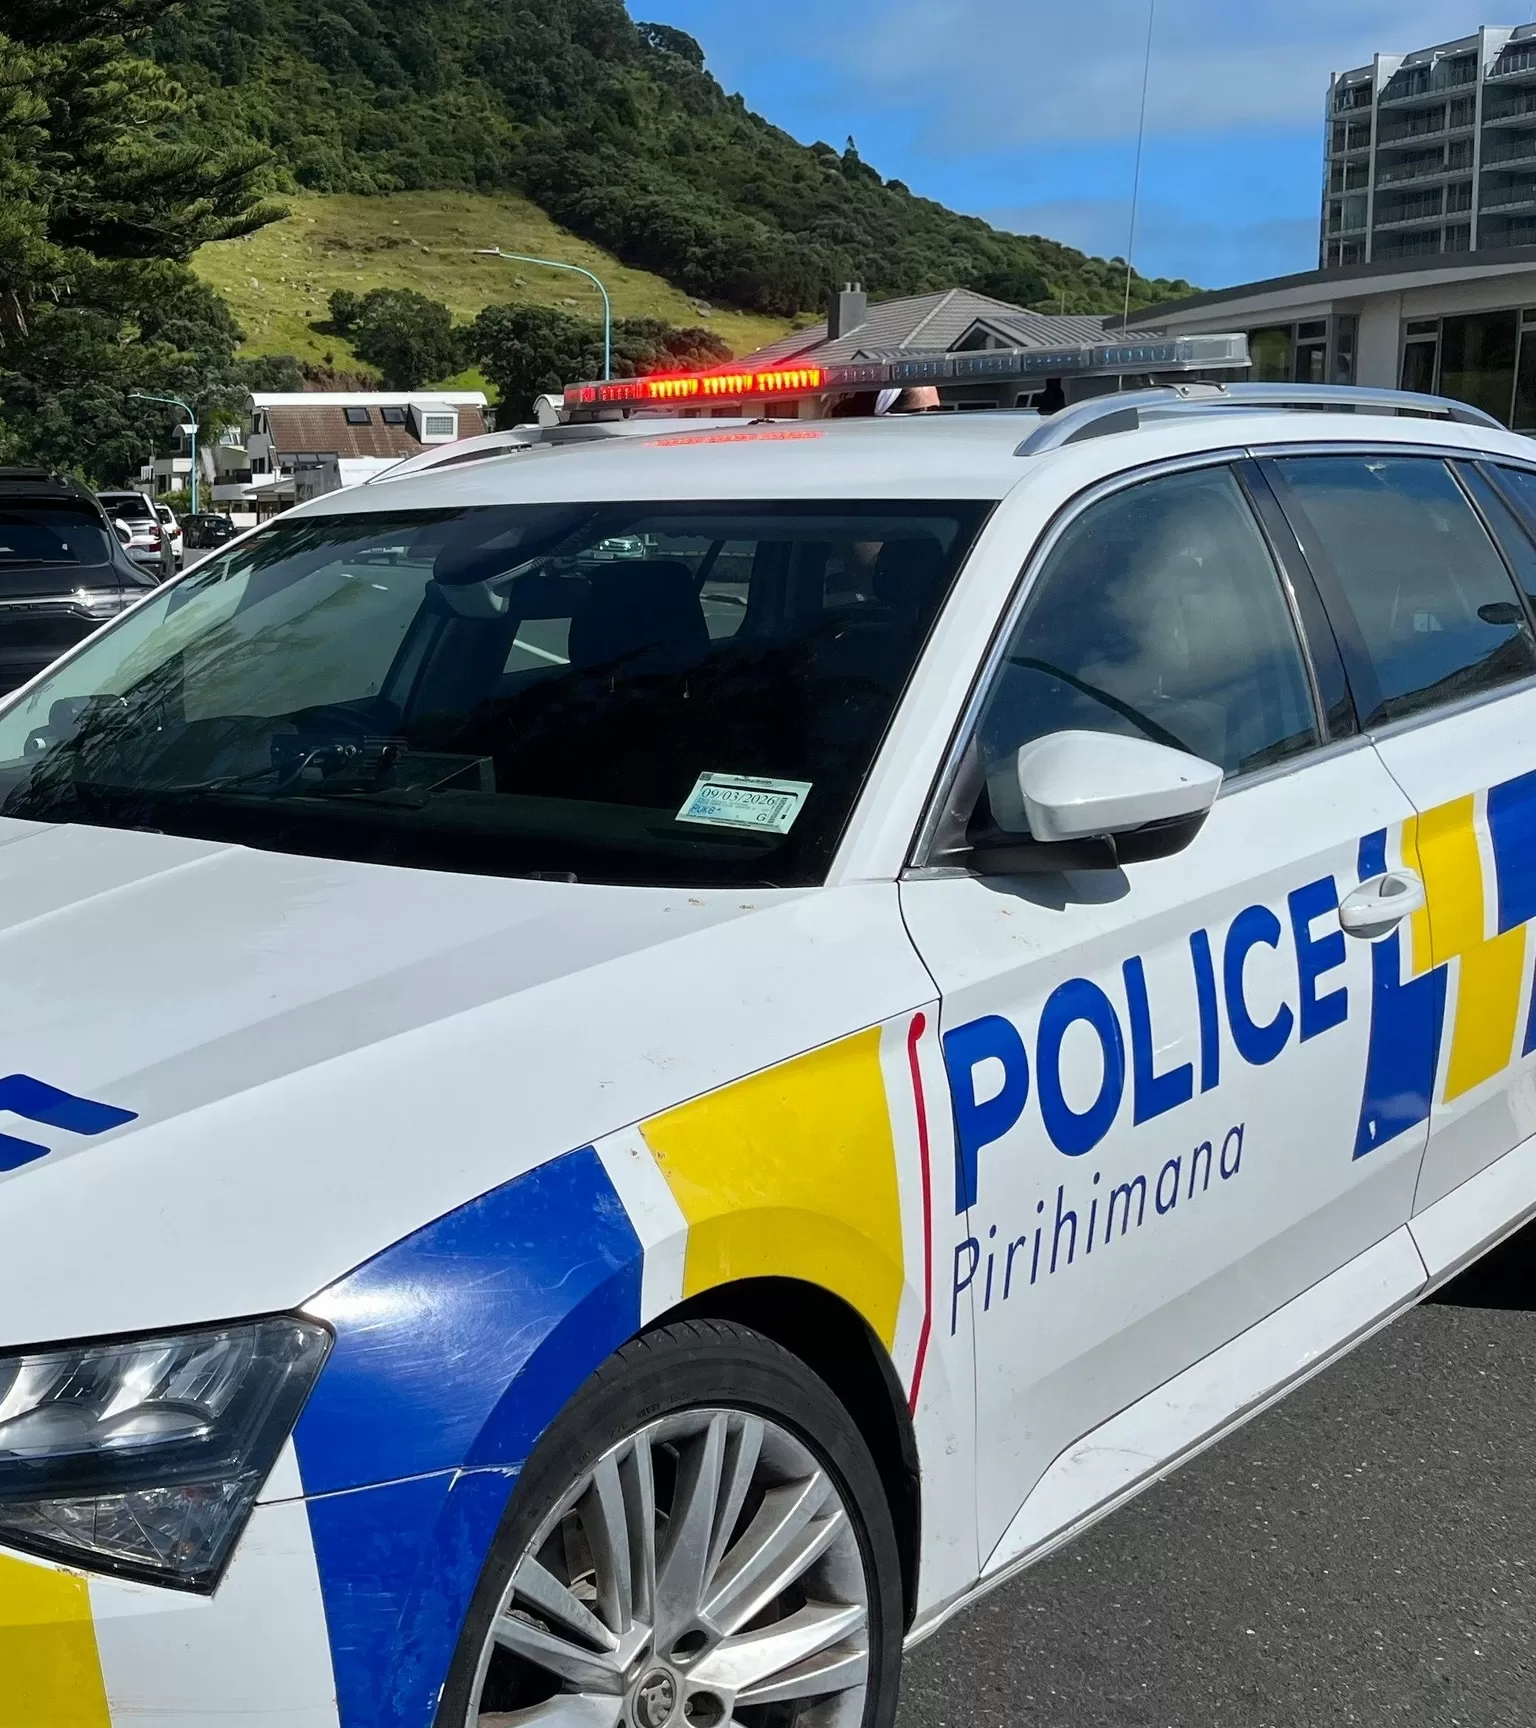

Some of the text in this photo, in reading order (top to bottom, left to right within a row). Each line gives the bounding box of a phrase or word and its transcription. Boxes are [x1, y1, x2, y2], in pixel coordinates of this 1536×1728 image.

[701, 788, 775, 806] 09/03/2026
[755, 812, 768, 823] G
[942, 874, 1349, 1216] POLICE
[950, 1122, 1246, 1337] Pirihimana
